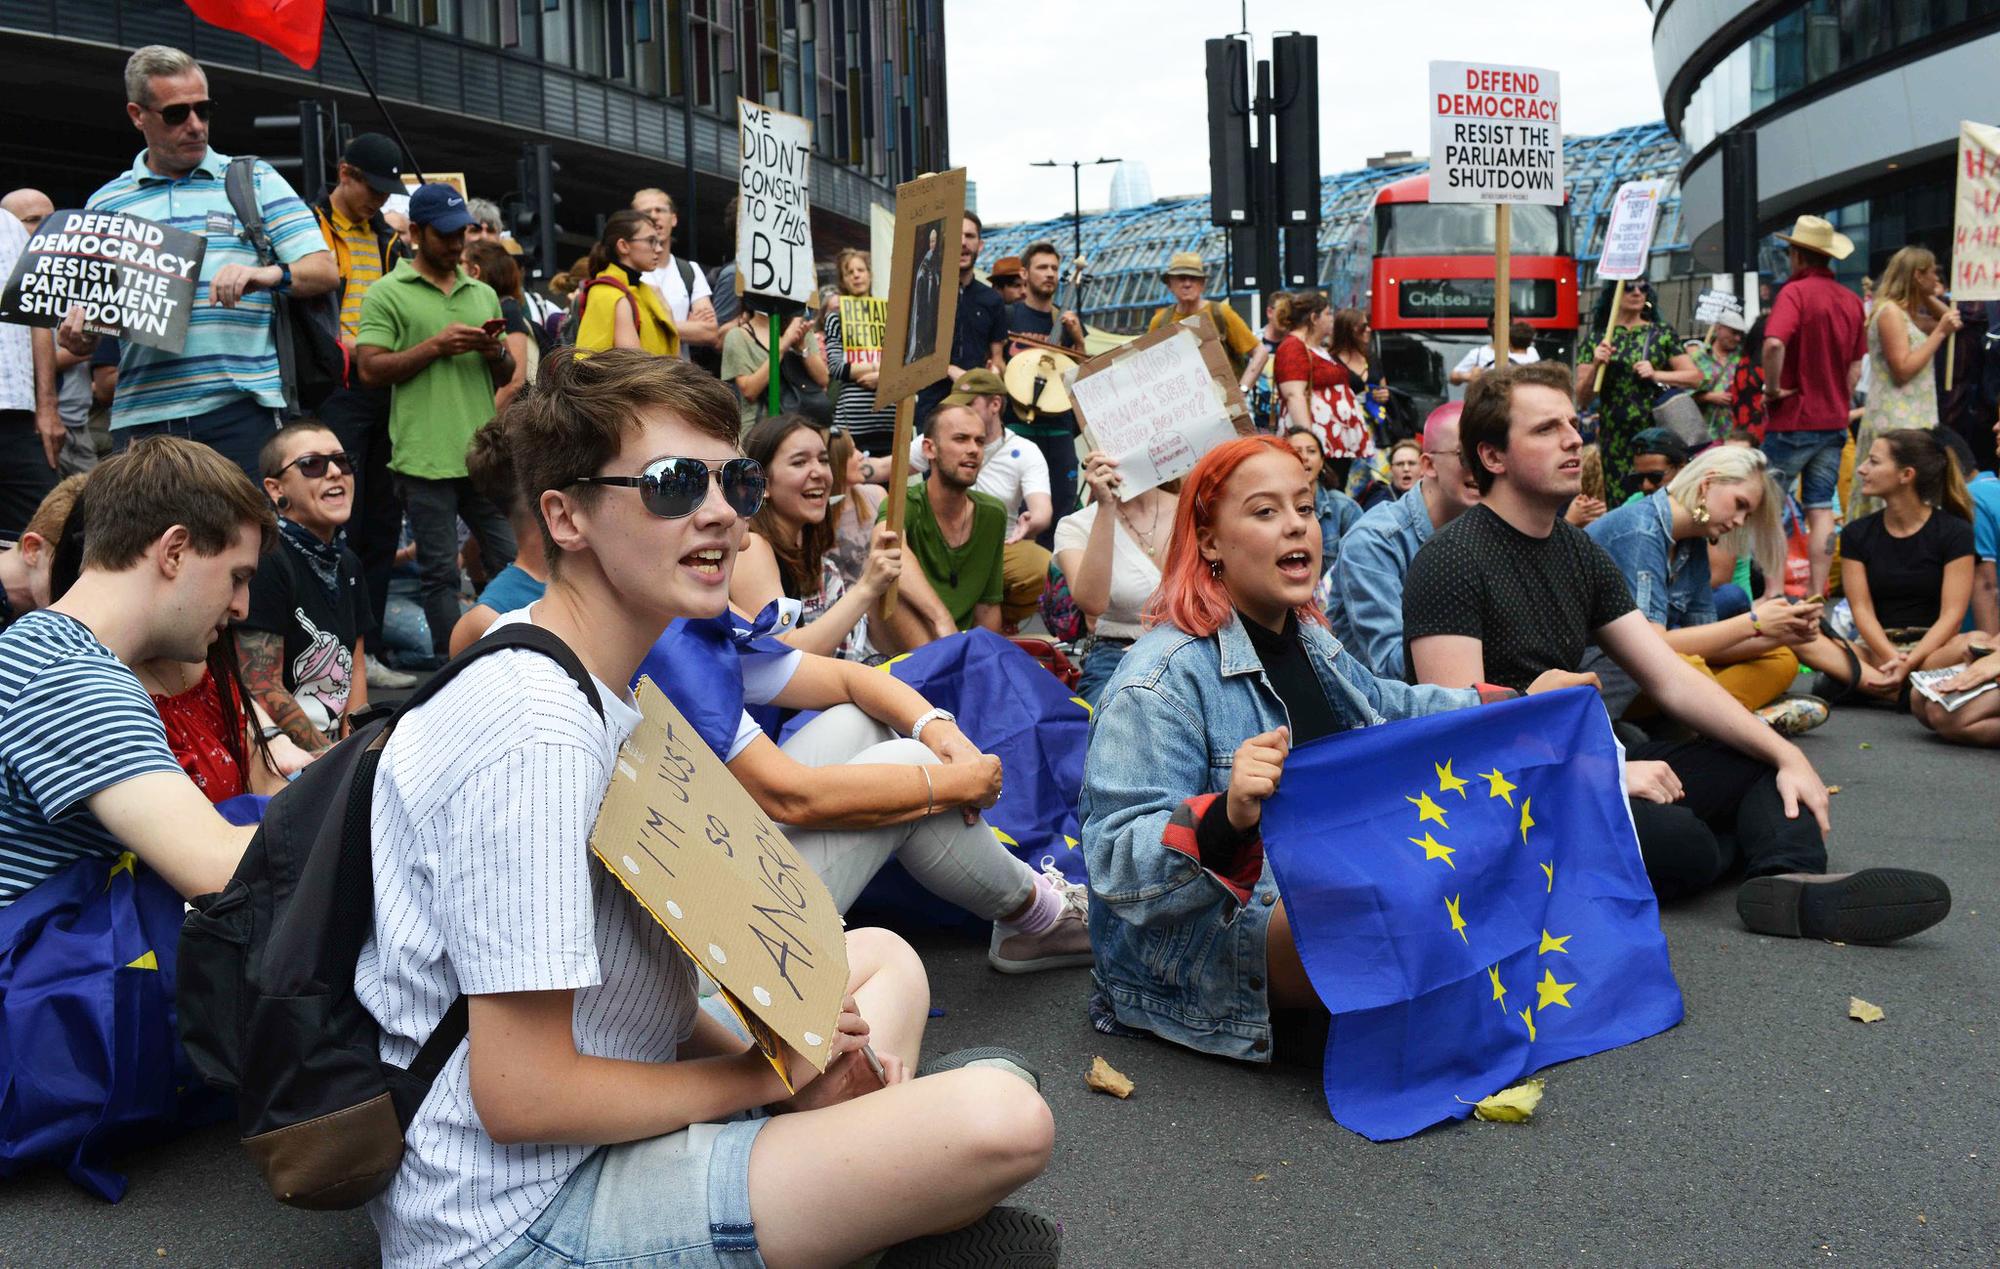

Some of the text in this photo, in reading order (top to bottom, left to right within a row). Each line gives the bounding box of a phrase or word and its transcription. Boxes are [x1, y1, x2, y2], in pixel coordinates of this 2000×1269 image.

[1467, 69, 1539, 93] DEFEND
[743, 104, 771, 129] WE
[1438, 94, 1558, 121] DEMOCRACY
[743, 124, 810, 181] DIDN'T
[1455, 123, 1549, 147] RESIST THE
[1446, 145, 1555, 169] PARLIAMENT
[741, 165, 809, 211] CONSENT
[1448, 168, 1554, 191] SHUTDOWN
[64, 214, 164, 246] DEFEND
[744, 193, 808, 246] TO THIS
[29, 234, 196, 278] DEMOCRACY
[35, 256, 171, 297] RESIST THE
[752, 231, 798, 296] BJ
[20, 273, 178, 317] PARLIAMENT
[1408, 290, 1471, 307] Chelsea
[1128, 341, 1182, 388] KIDS
[1153, 374, 1190, 406] SEE
[1151, 391, 1208, 431] BODY?
[637, 721, 696, 878] I'M JUST
[705, 814, 734, 858] SO
[748, 814, 814, 1001] ANGRY
